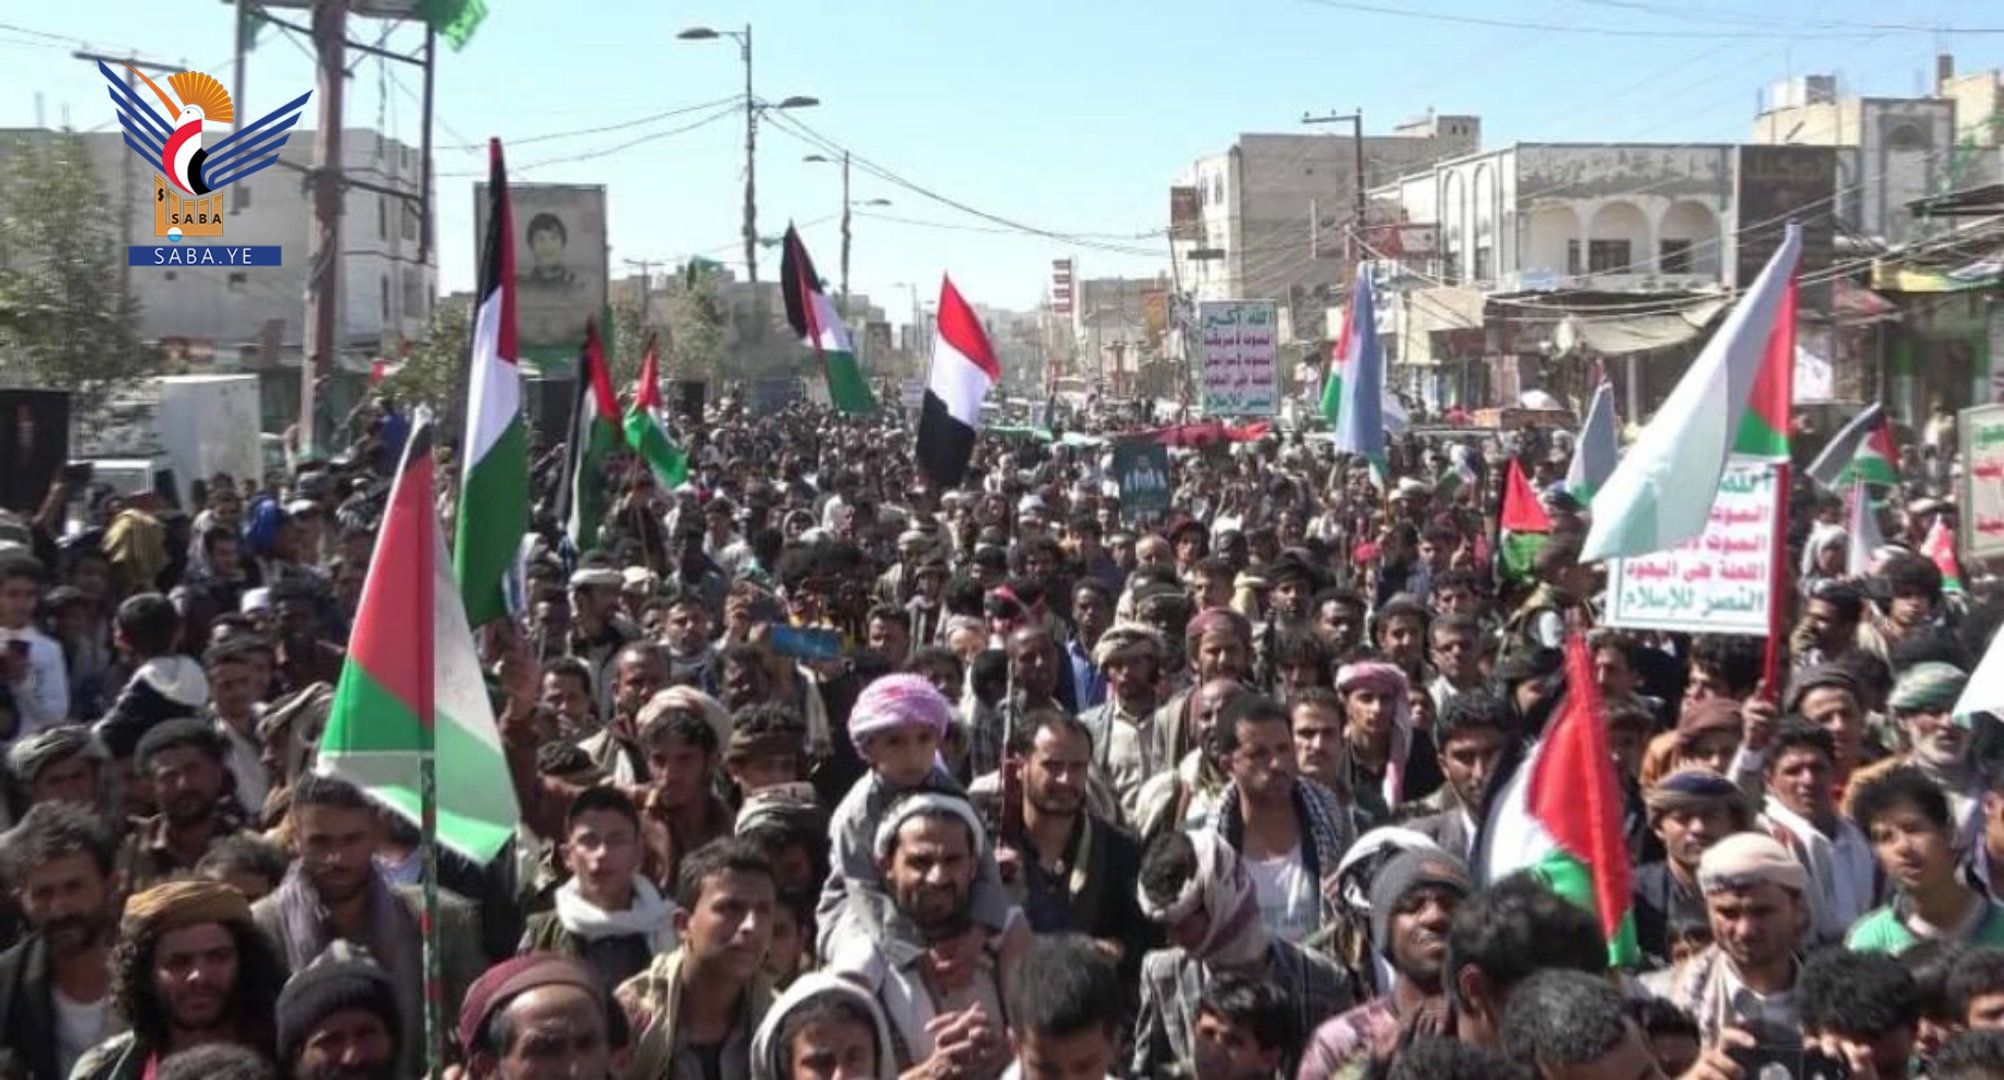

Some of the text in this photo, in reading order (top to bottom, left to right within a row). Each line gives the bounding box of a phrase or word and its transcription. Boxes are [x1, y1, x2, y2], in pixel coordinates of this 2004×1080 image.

[1626, 560, 1678, 581] اليهود
[1720, 559, 1764, 580] اللعنة
[1623, 584, 1765, 617] النصر للإسلام
